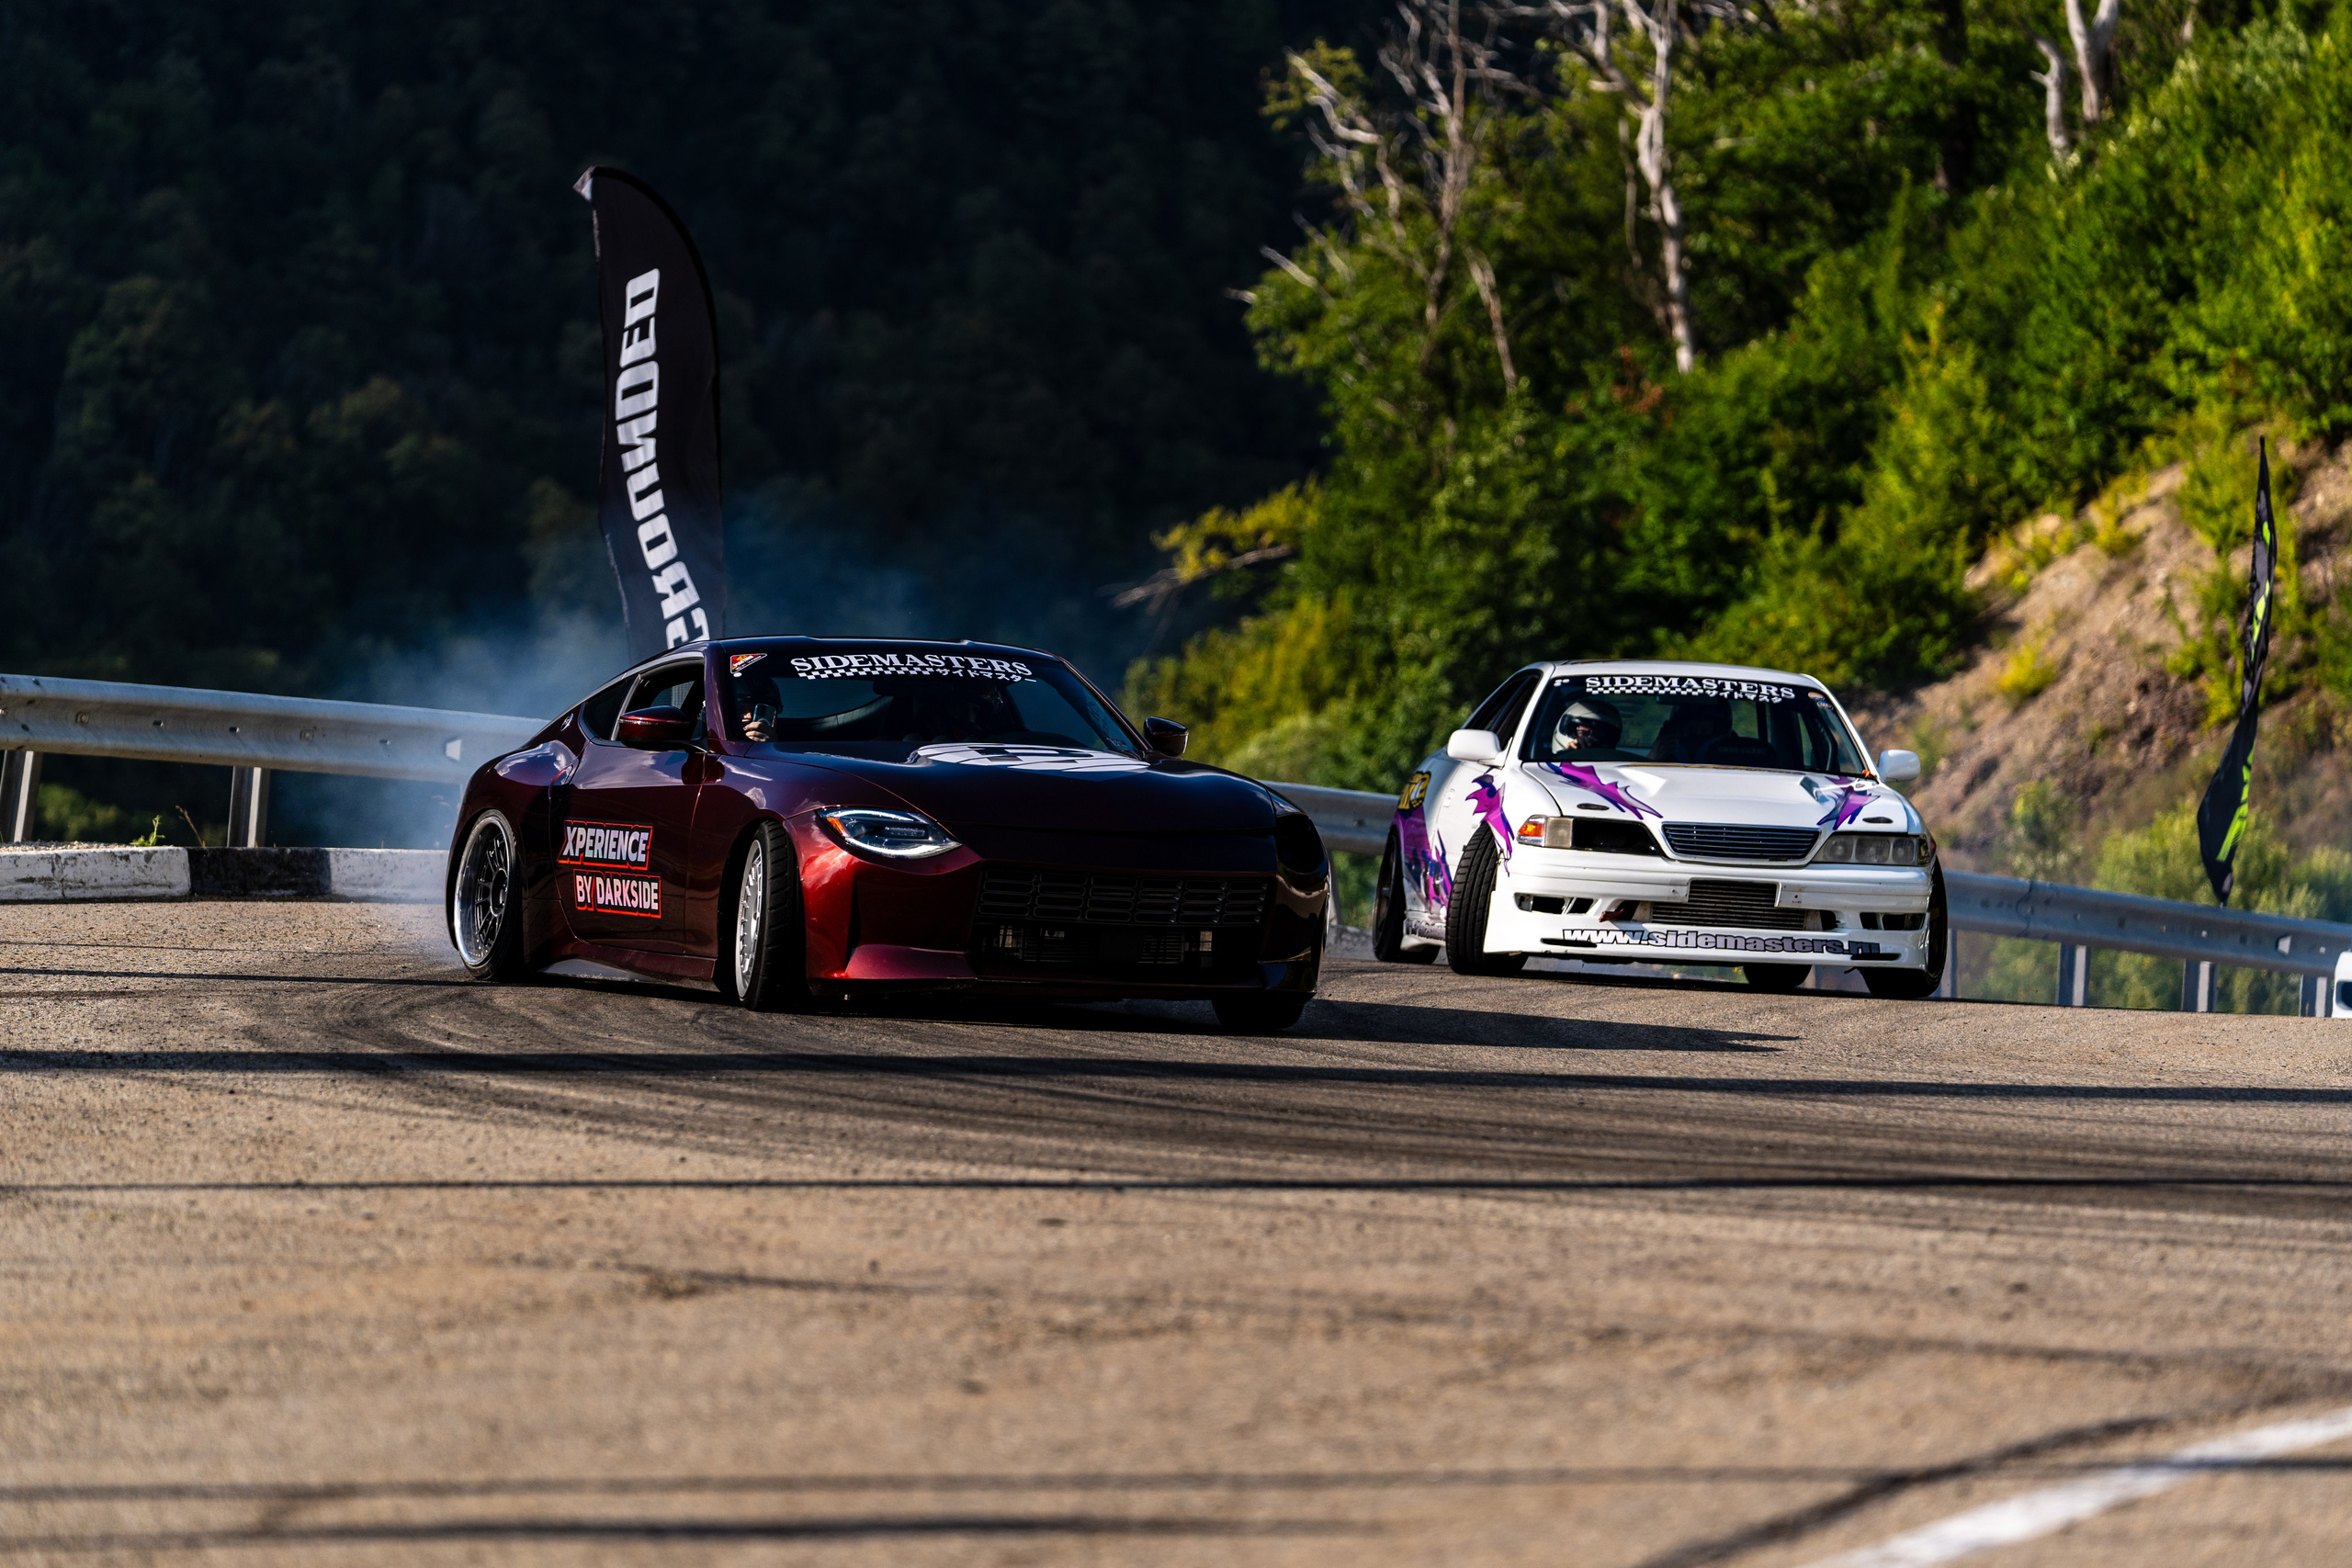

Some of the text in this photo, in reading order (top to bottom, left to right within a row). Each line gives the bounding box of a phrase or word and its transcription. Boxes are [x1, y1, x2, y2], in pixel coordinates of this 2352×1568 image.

[790, 653, 1033, 676] SIDEMASTERS
[935, 668, 1037, 682] サイドマスター
[1585, 676, 1795, 699] SIDEMASTERS
[562, 826, 650, 863] XPERIENCE
[575, 874, 659, 910] BY DARKSIDE
[1562, 929, 1881, 954] www.sidemasters.ru
